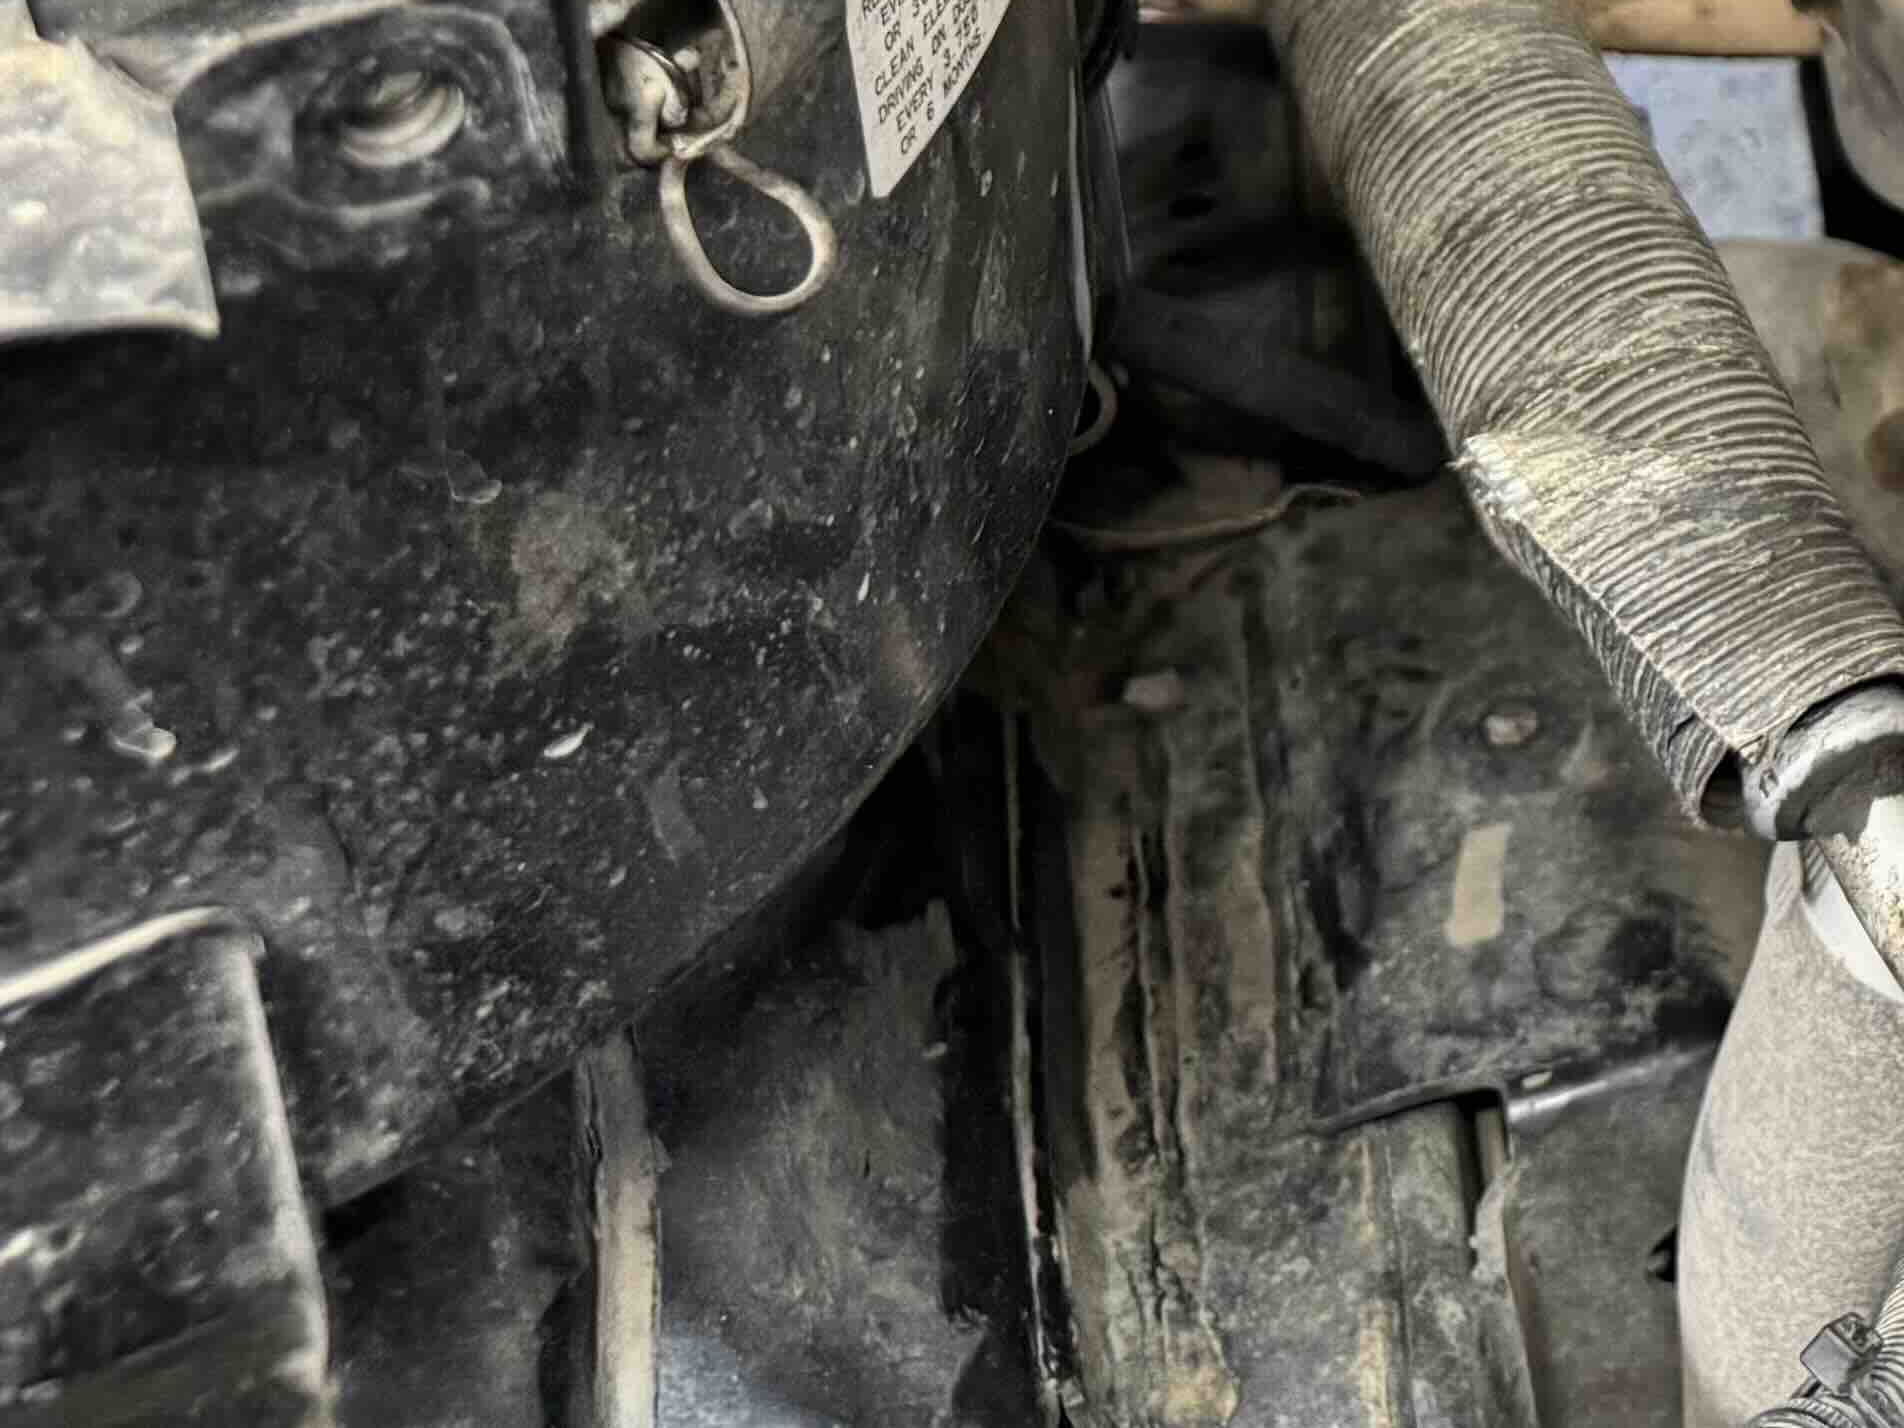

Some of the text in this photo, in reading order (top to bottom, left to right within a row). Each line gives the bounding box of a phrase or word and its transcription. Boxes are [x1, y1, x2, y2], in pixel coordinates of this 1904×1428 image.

[874, 35, 916, 97] CLEAN
[884, 21, 902, 52] OR
[878, 55, 924, 125] DRIVING
[931, 23, 947, 56] ON
[896, 68, 934, 134] EVERY
[900, 124, 917, 155] OR
[926, 100, 935, 121] 6
